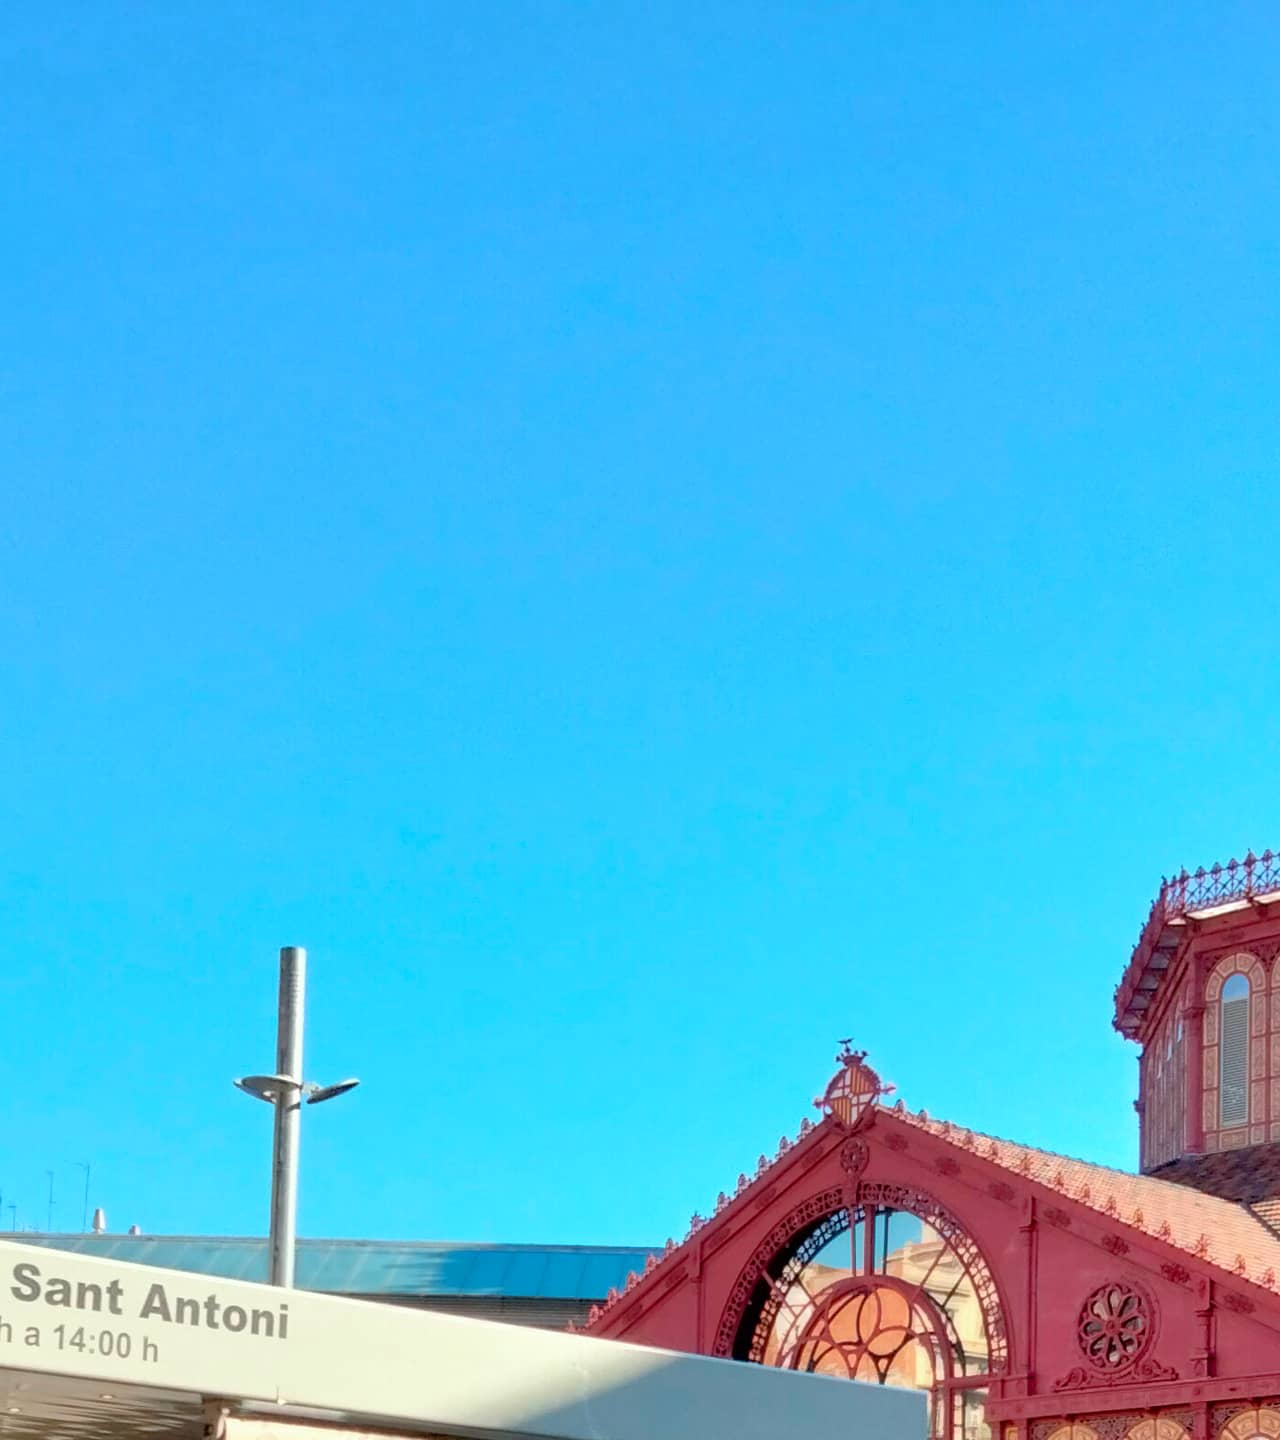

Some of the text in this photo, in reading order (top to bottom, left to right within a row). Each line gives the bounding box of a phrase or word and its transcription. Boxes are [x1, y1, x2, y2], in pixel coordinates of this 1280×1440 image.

[9, 1262, 125, 1316] Sant
[138, 1282, 289, 1340] Antoni
[23, 1326, 41, 1348] a
[53, 1323, 132, 1359] 14:00
[142, 1335, 160, 1363] h
